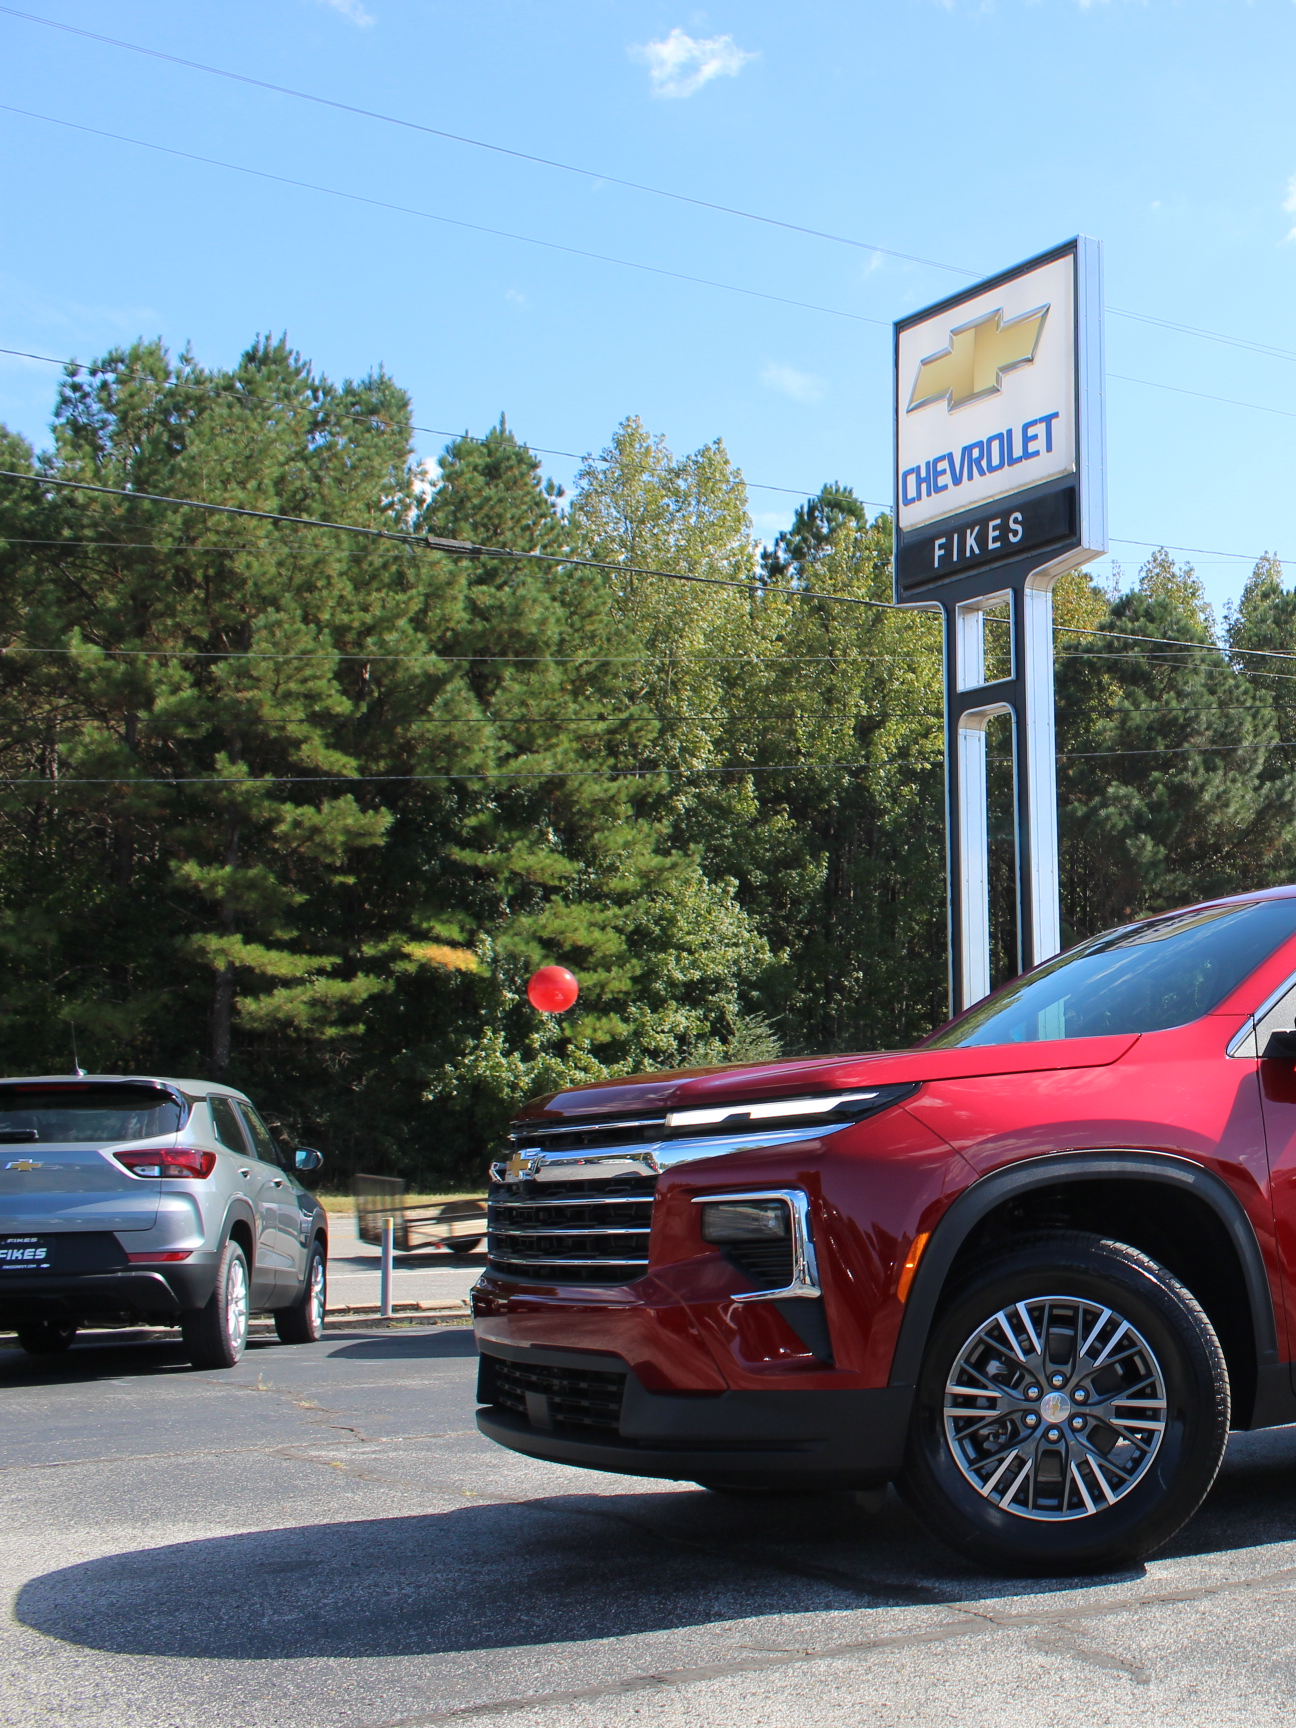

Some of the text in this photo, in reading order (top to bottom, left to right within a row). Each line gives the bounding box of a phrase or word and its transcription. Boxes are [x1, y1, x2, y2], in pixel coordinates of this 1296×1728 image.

[901, 411, 1059, 506] CHEVROLET
[934, 512, 1023, 568] FIKES
[0, 1247, 47, 1260] FIKES
